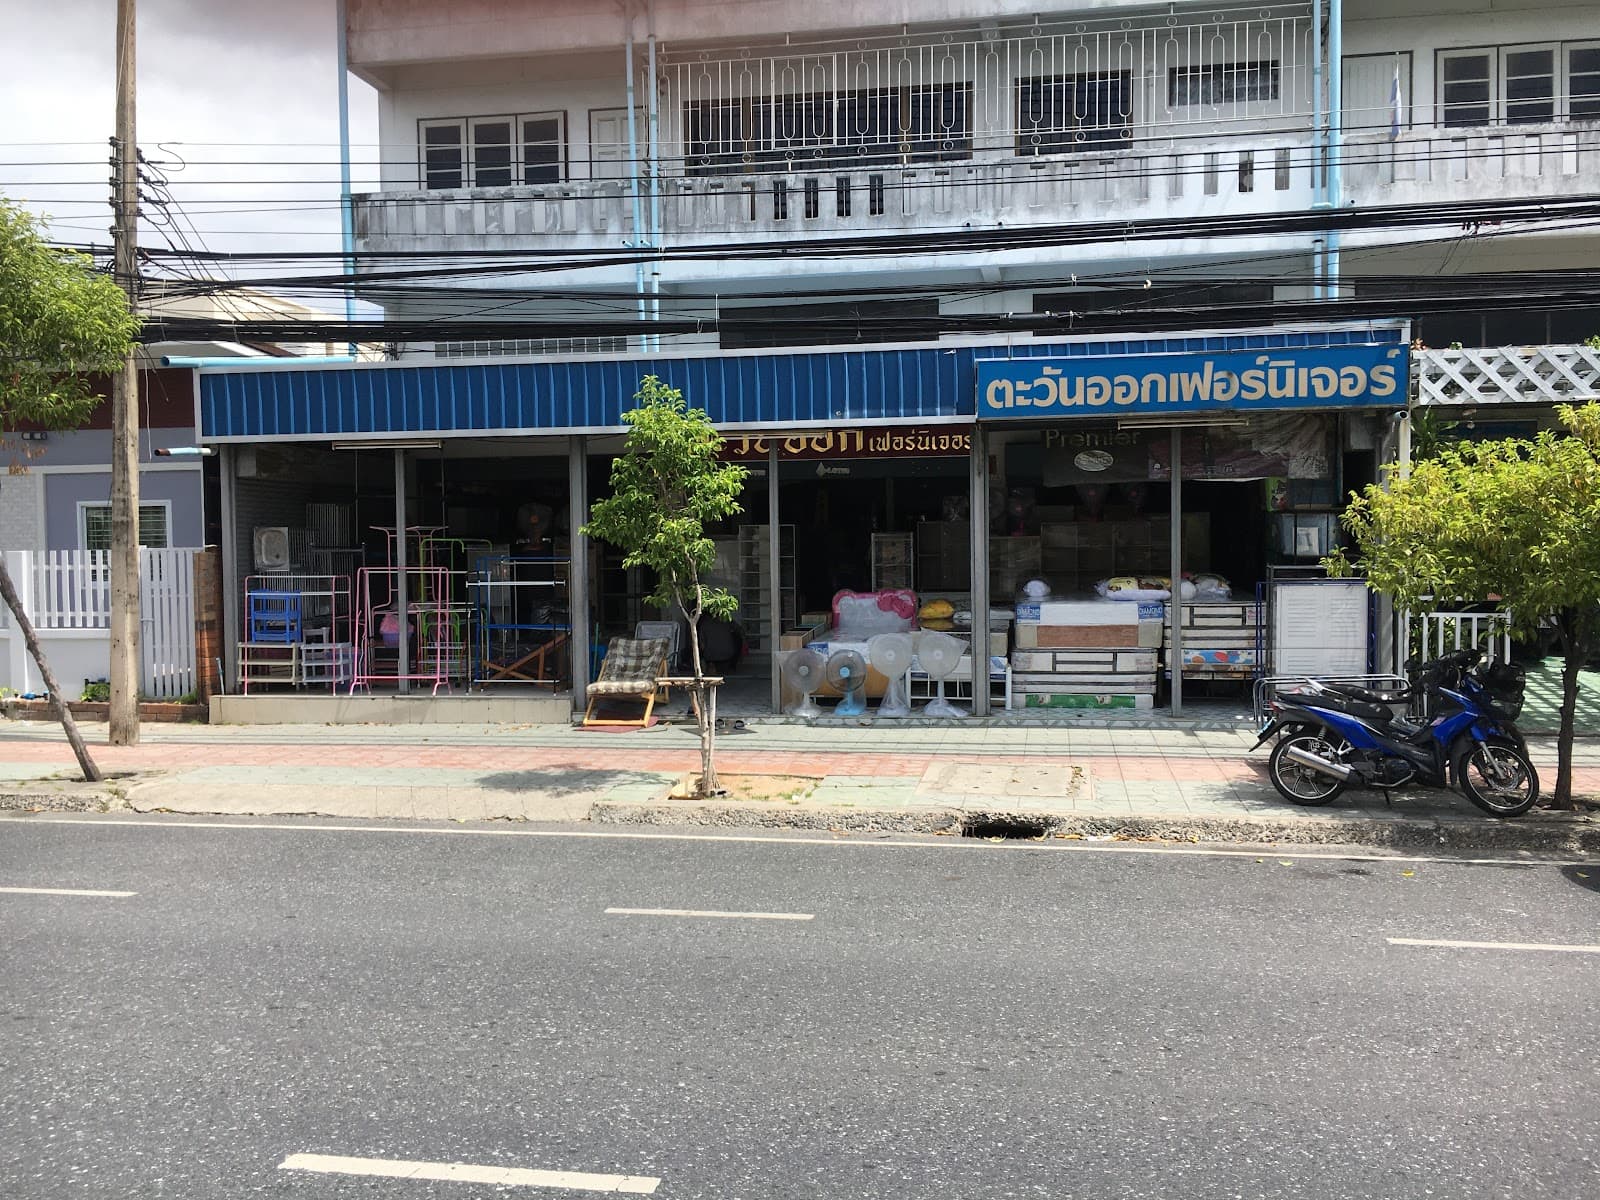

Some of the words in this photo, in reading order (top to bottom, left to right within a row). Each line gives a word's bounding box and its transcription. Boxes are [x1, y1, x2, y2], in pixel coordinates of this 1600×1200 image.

[986, 348, 1400, 409] ตะวันออกเฟอร์นิเจอร์
